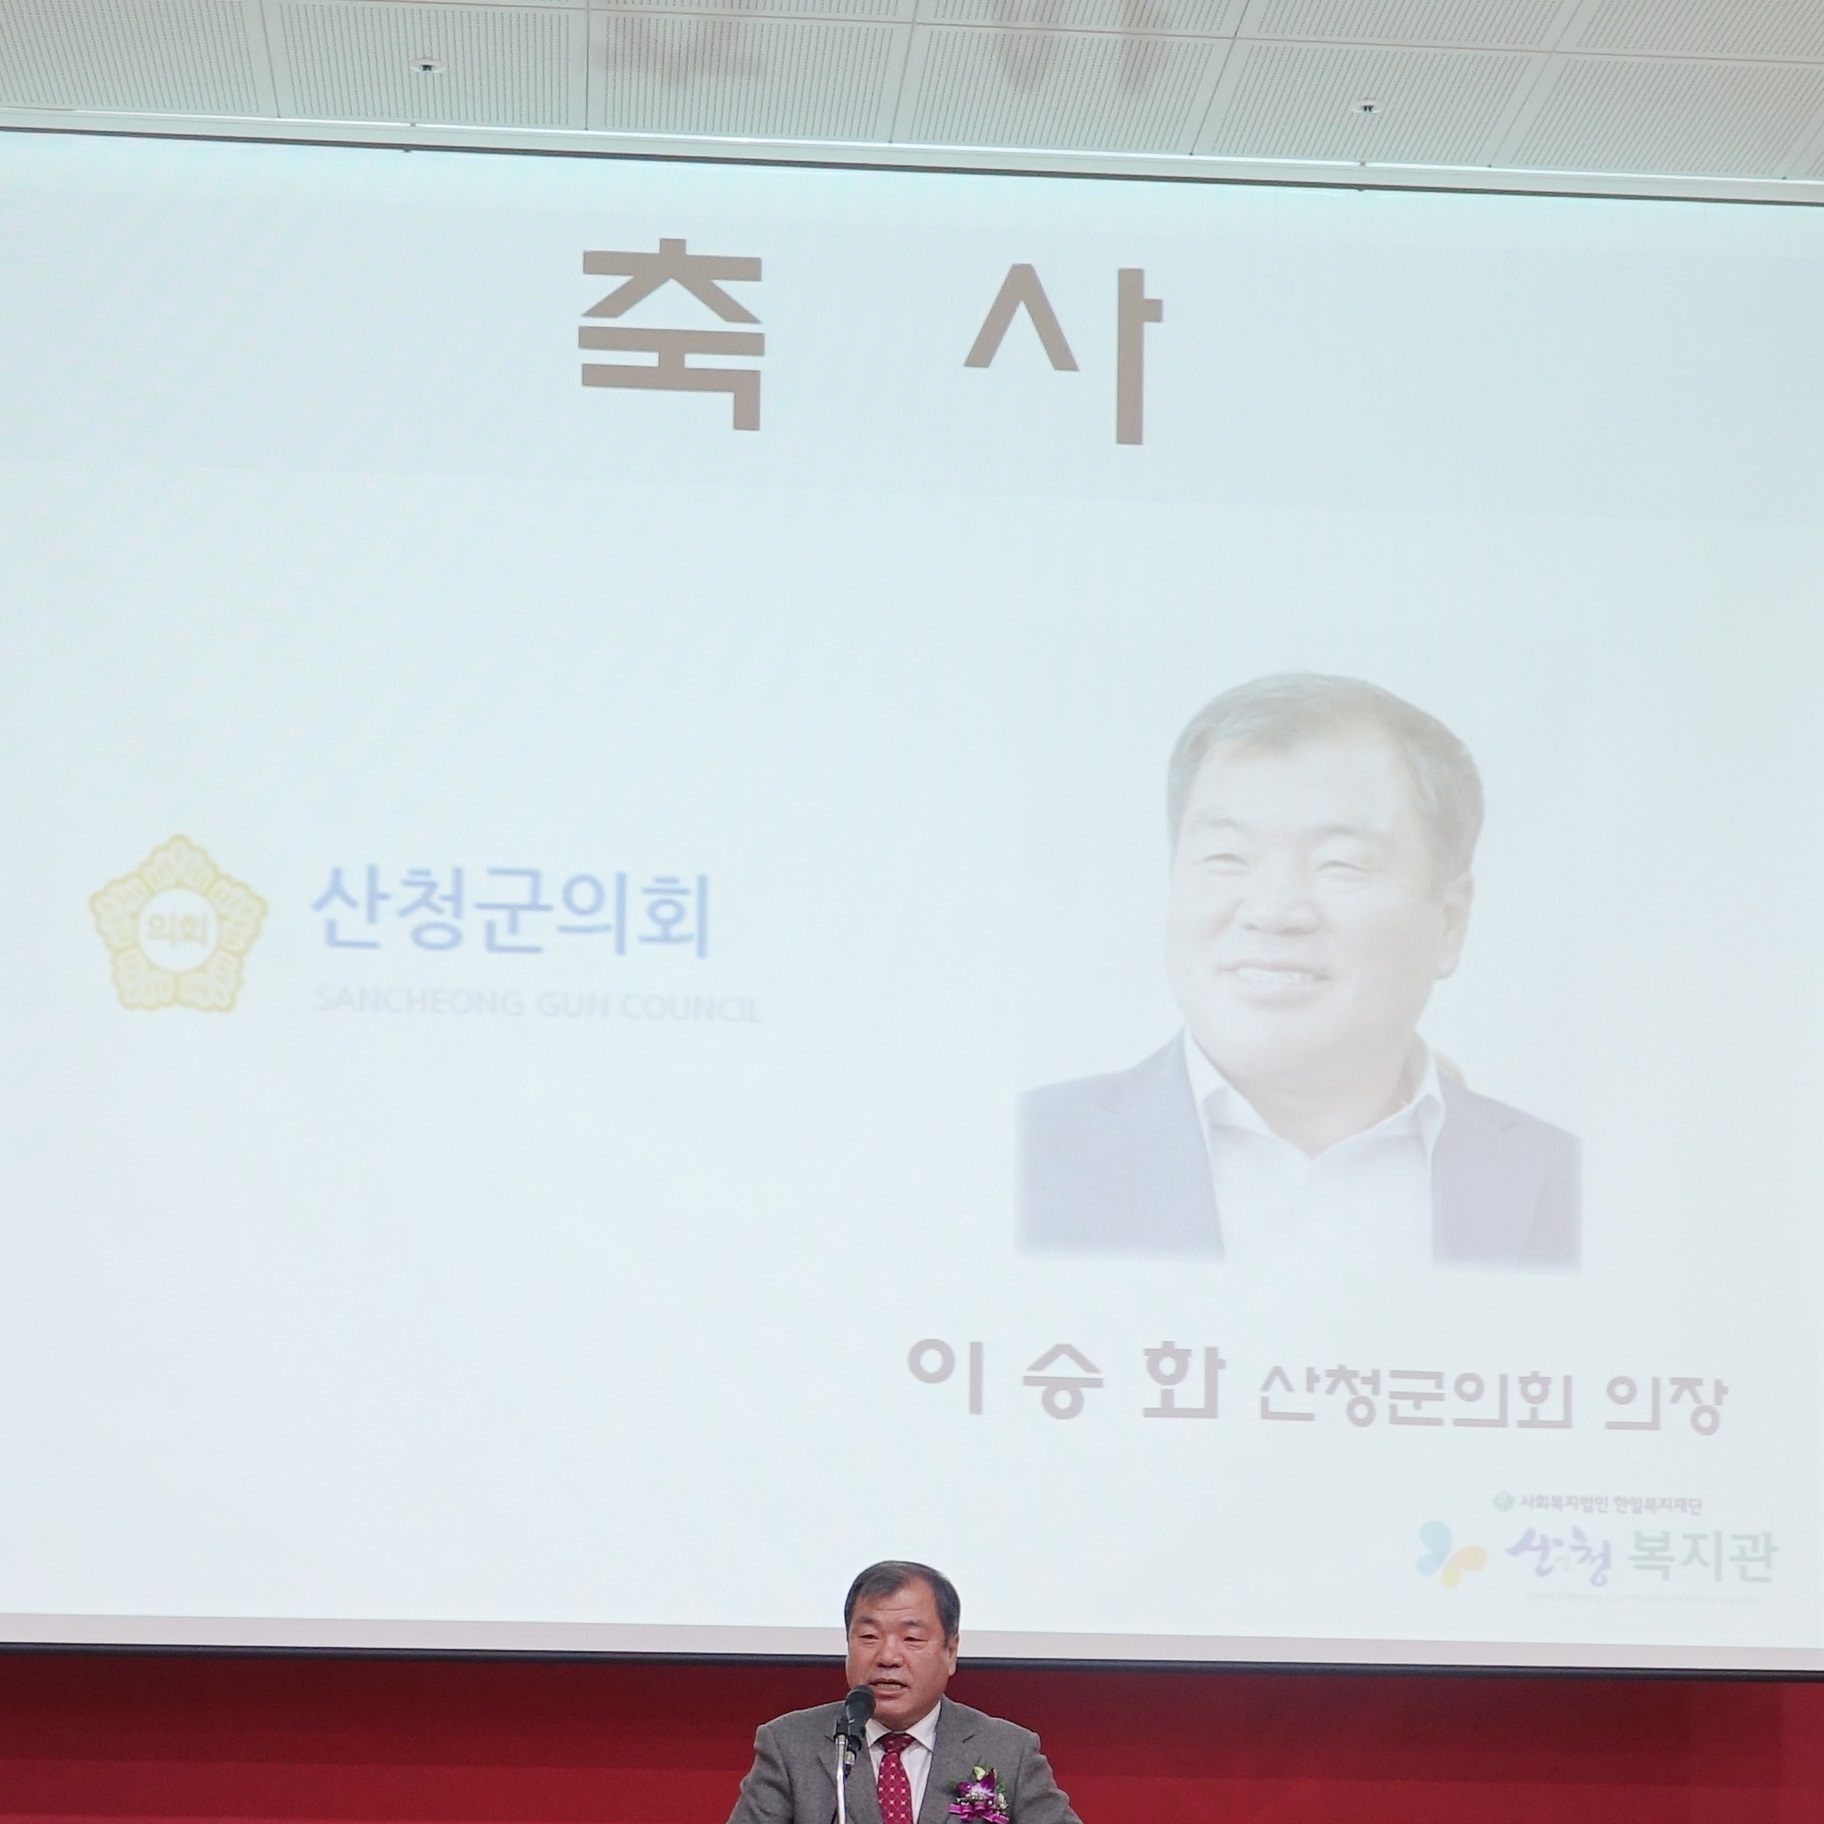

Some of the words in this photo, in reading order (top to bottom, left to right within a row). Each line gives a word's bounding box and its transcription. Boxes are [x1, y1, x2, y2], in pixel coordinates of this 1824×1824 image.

[311, 864, 711, 959] 산청군의회
[313, 983, 525, 1017] SANCHEONG
[537, 989, 612, 1019] GUN
[621, 992, 763, 1024] COUNCIL
[1259, 1364, 1573, 1429] 산청군의회
[1605, 1374, 1729, 1436] 의장
[1519, 1494, 1609, 1514] 사회복지법인
[1629, 1530, 1779, 1584] 복지관
